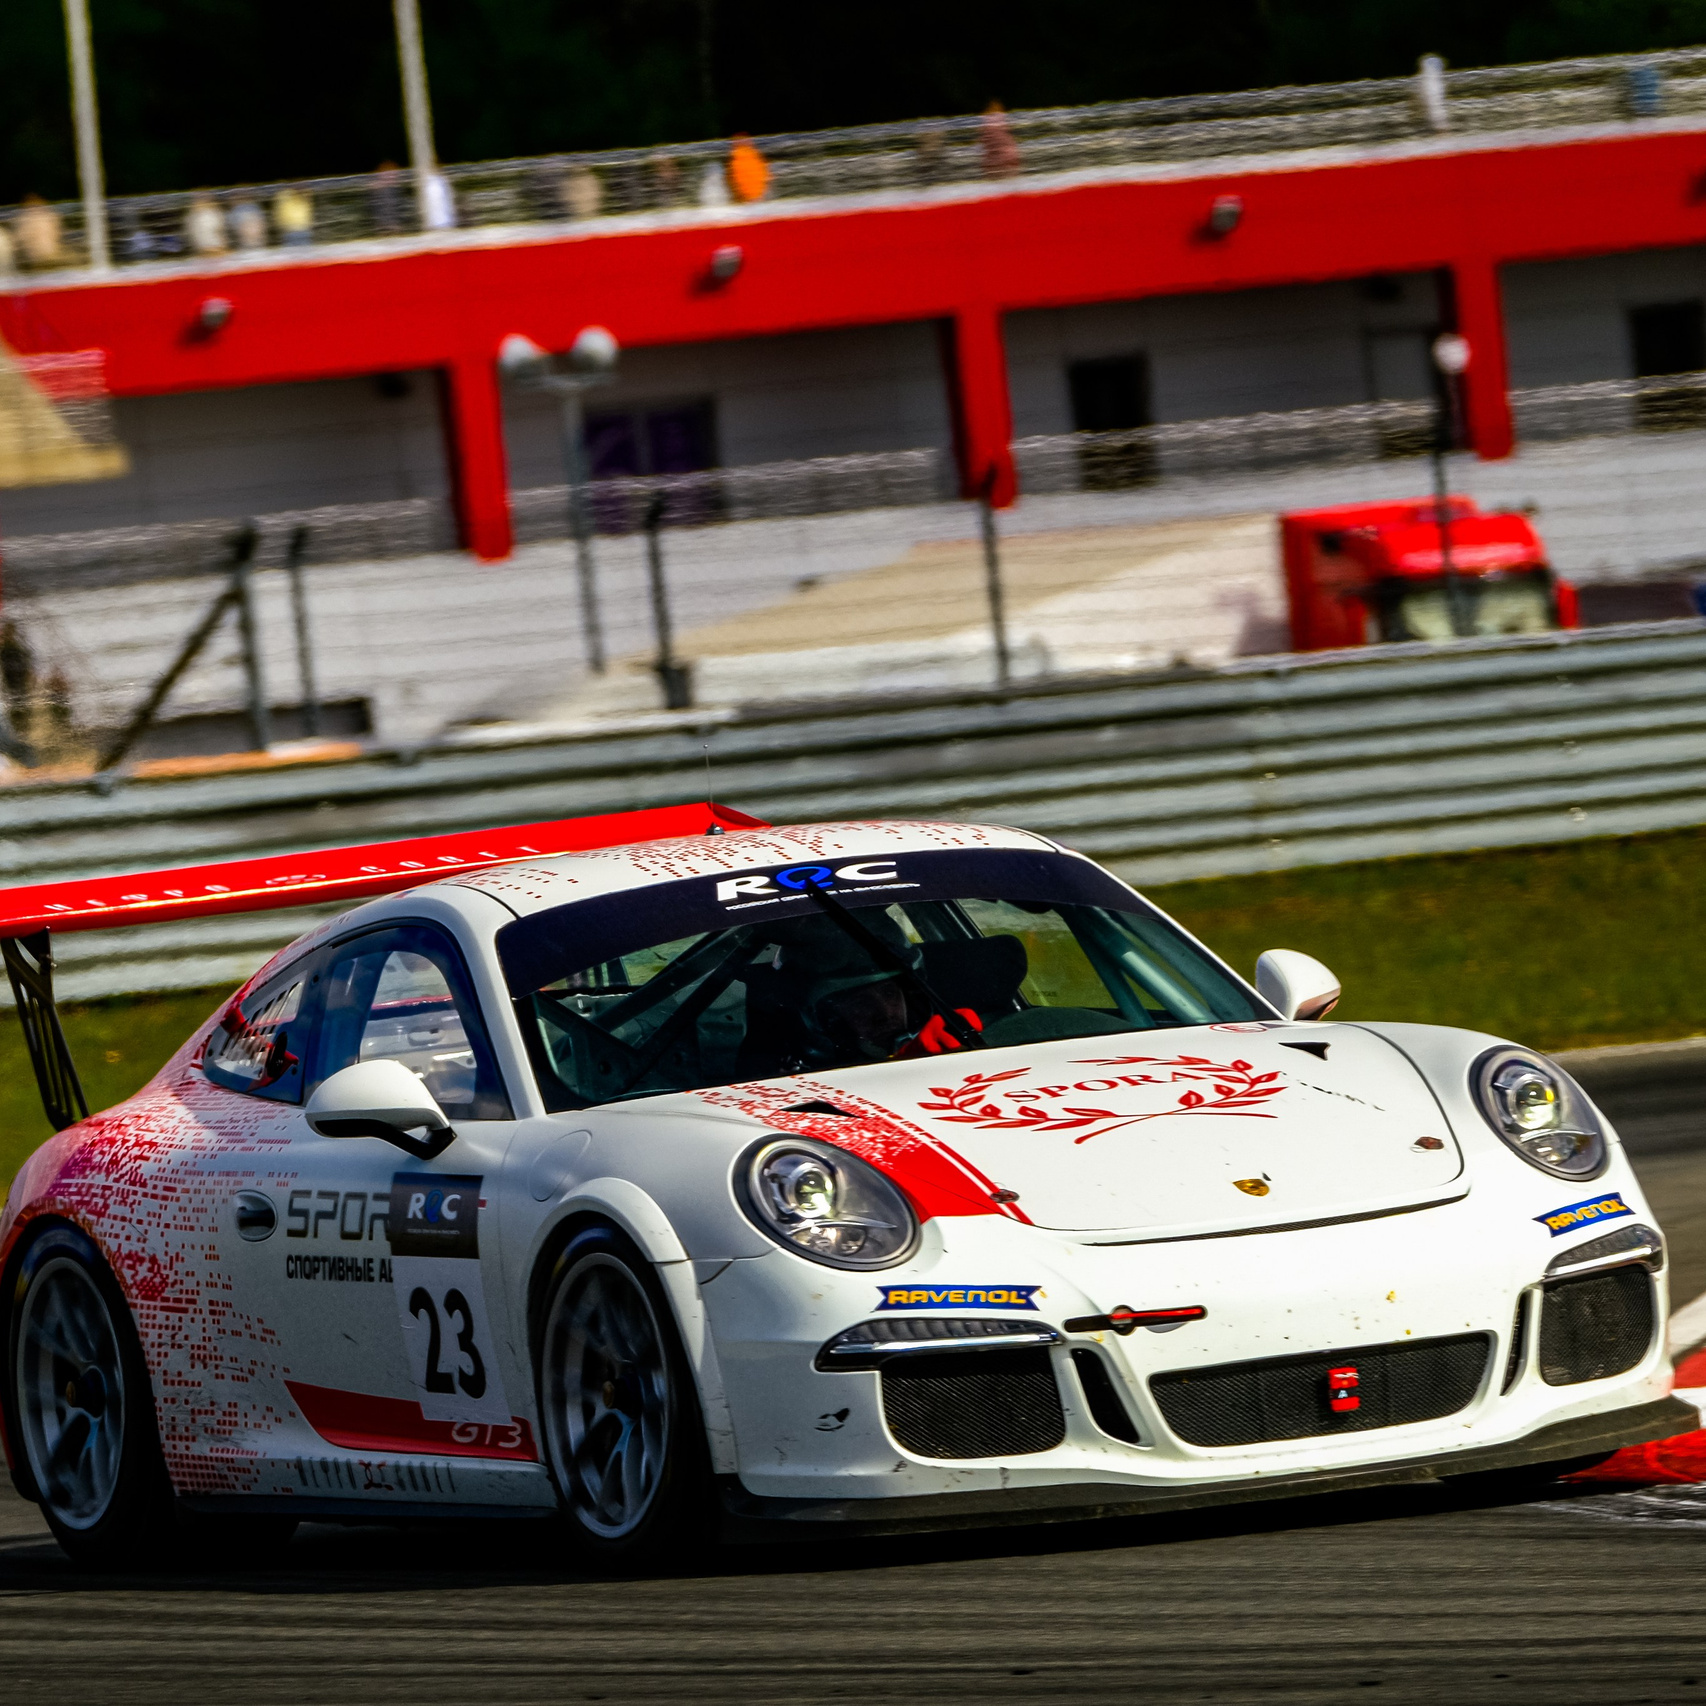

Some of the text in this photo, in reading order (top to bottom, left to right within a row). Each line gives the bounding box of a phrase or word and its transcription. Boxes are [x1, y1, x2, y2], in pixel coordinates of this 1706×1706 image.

[1003, 1071, 1210, 1103] SPORA
[1545, 1199, 1629, 1230] RAVENOL
[286, 1254, 375, 1283] СПОРТИВНЫЕ
[887, 1289, 1027, 1305] RAVENOL
[409, 1286, 487, 1399] 23
